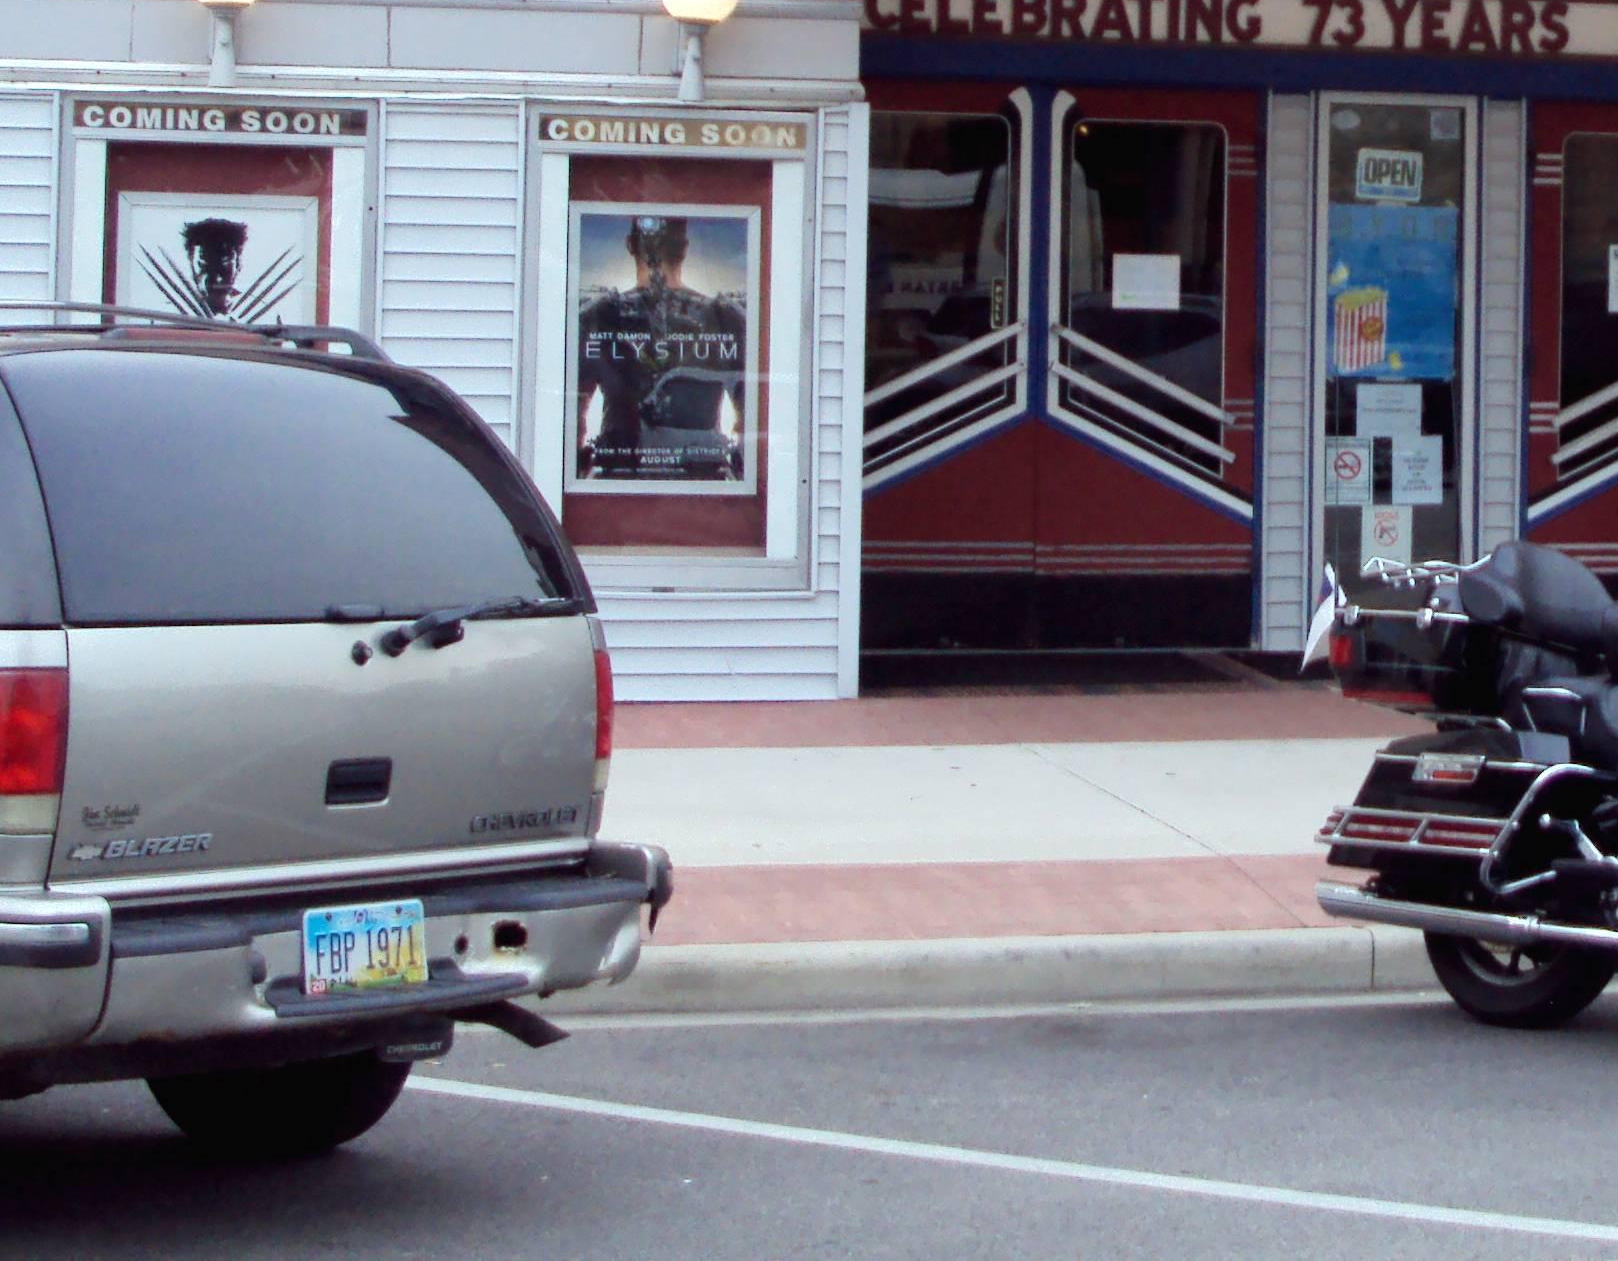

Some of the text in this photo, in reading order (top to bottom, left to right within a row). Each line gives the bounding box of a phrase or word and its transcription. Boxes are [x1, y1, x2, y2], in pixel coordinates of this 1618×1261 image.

[83, 105, 341, 135] COMING SOON
[548, 119, 796, 147] COMING SOON
[1364, 157, 1417, 187] OPEN
[589, 332, 613, 340] MATT
[586, 340, 738, 360] ELYSIUM
[640, 455, 682, 464] AUGUST
[103, 832, 213, 859] BLAZER
[315, 924, 417, 976] FBP 1971
